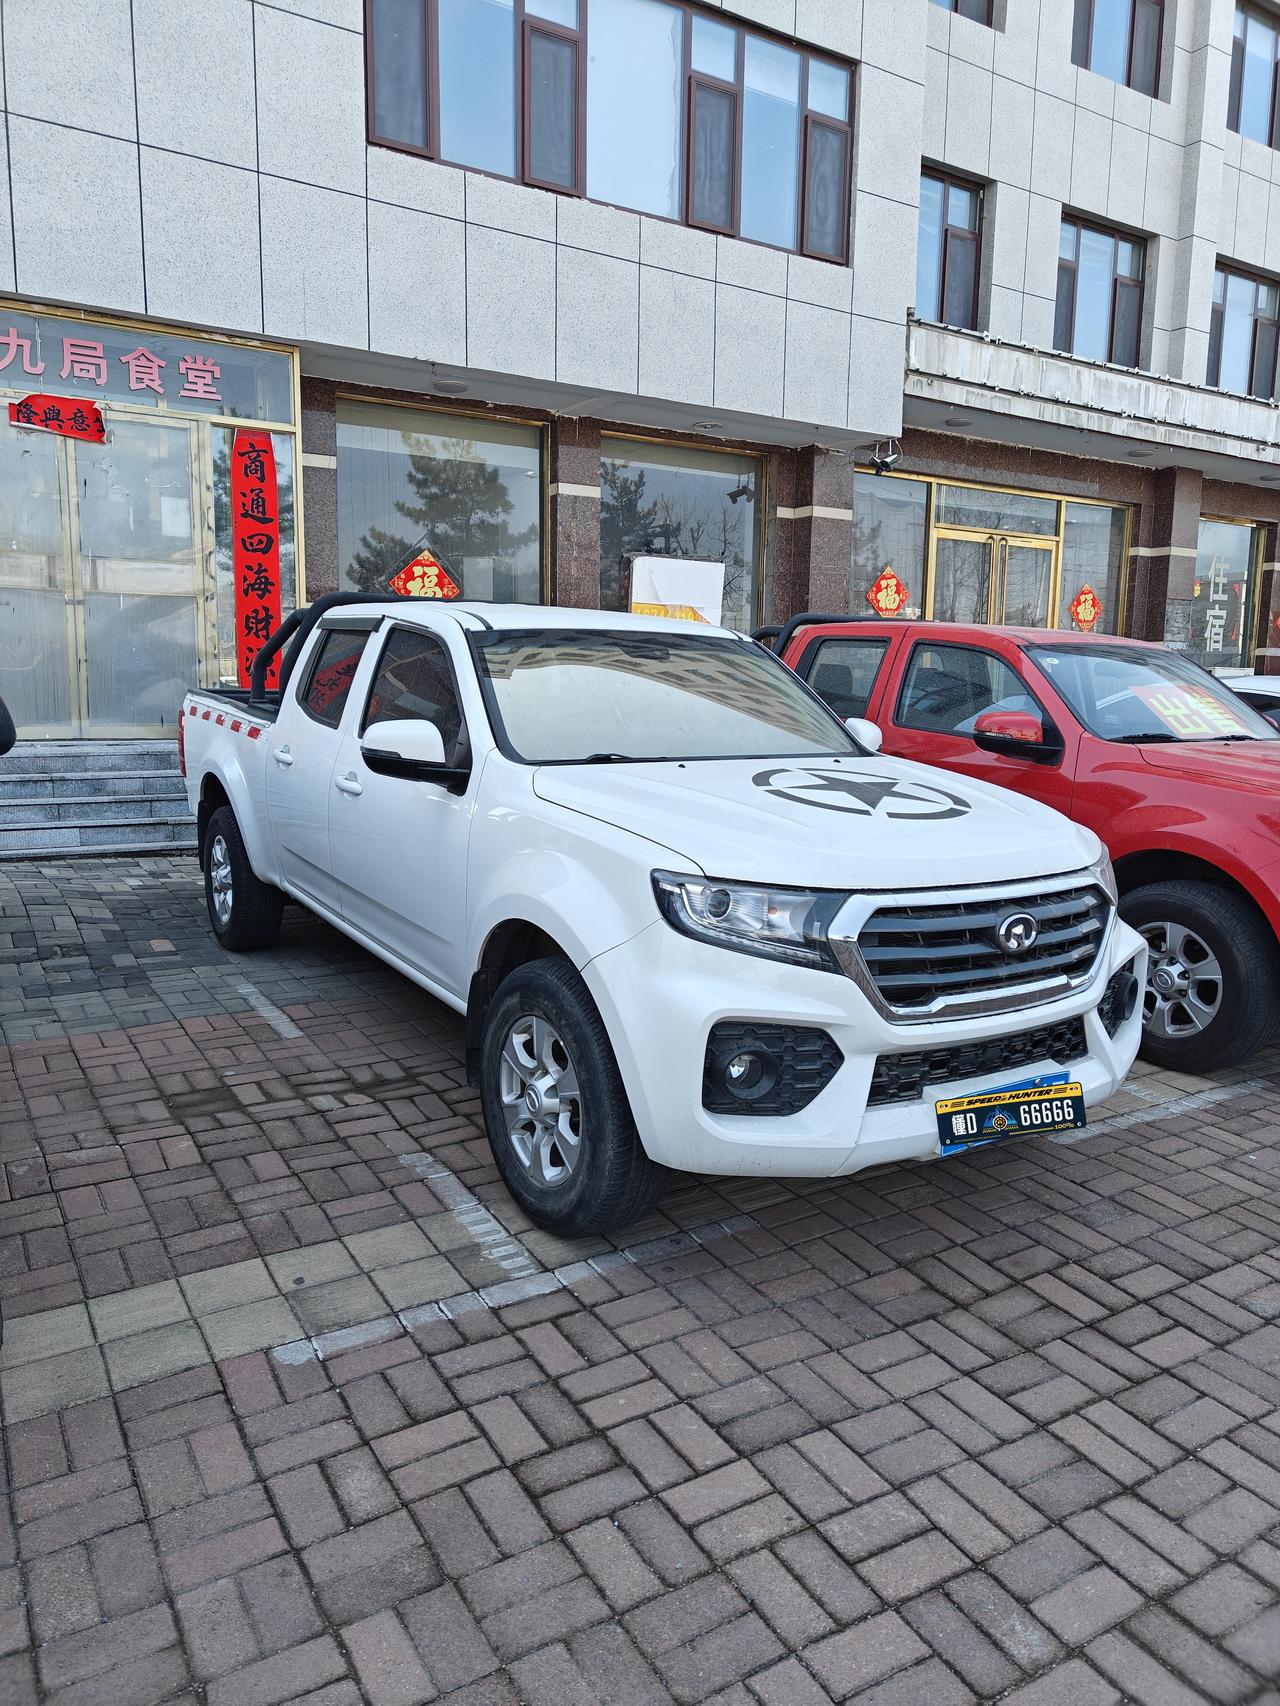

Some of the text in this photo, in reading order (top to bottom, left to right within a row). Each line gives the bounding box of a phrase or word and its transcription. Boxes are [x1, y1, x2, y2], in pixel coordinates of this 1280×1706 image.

[0, 327, 222, 401] 九局食堂
[406, 566, 443, 598] 福
[877, 578, 900, 610] 福
[1077, 593, 1096, 621] 福
[966, 1095, 1002, 1107] SPEED
[1007, 1089, 1053, 1101] HUNTER
[1020, 1099, 1074, 1126] 66666
[1054, 1121, 1075, 1130] 100%
